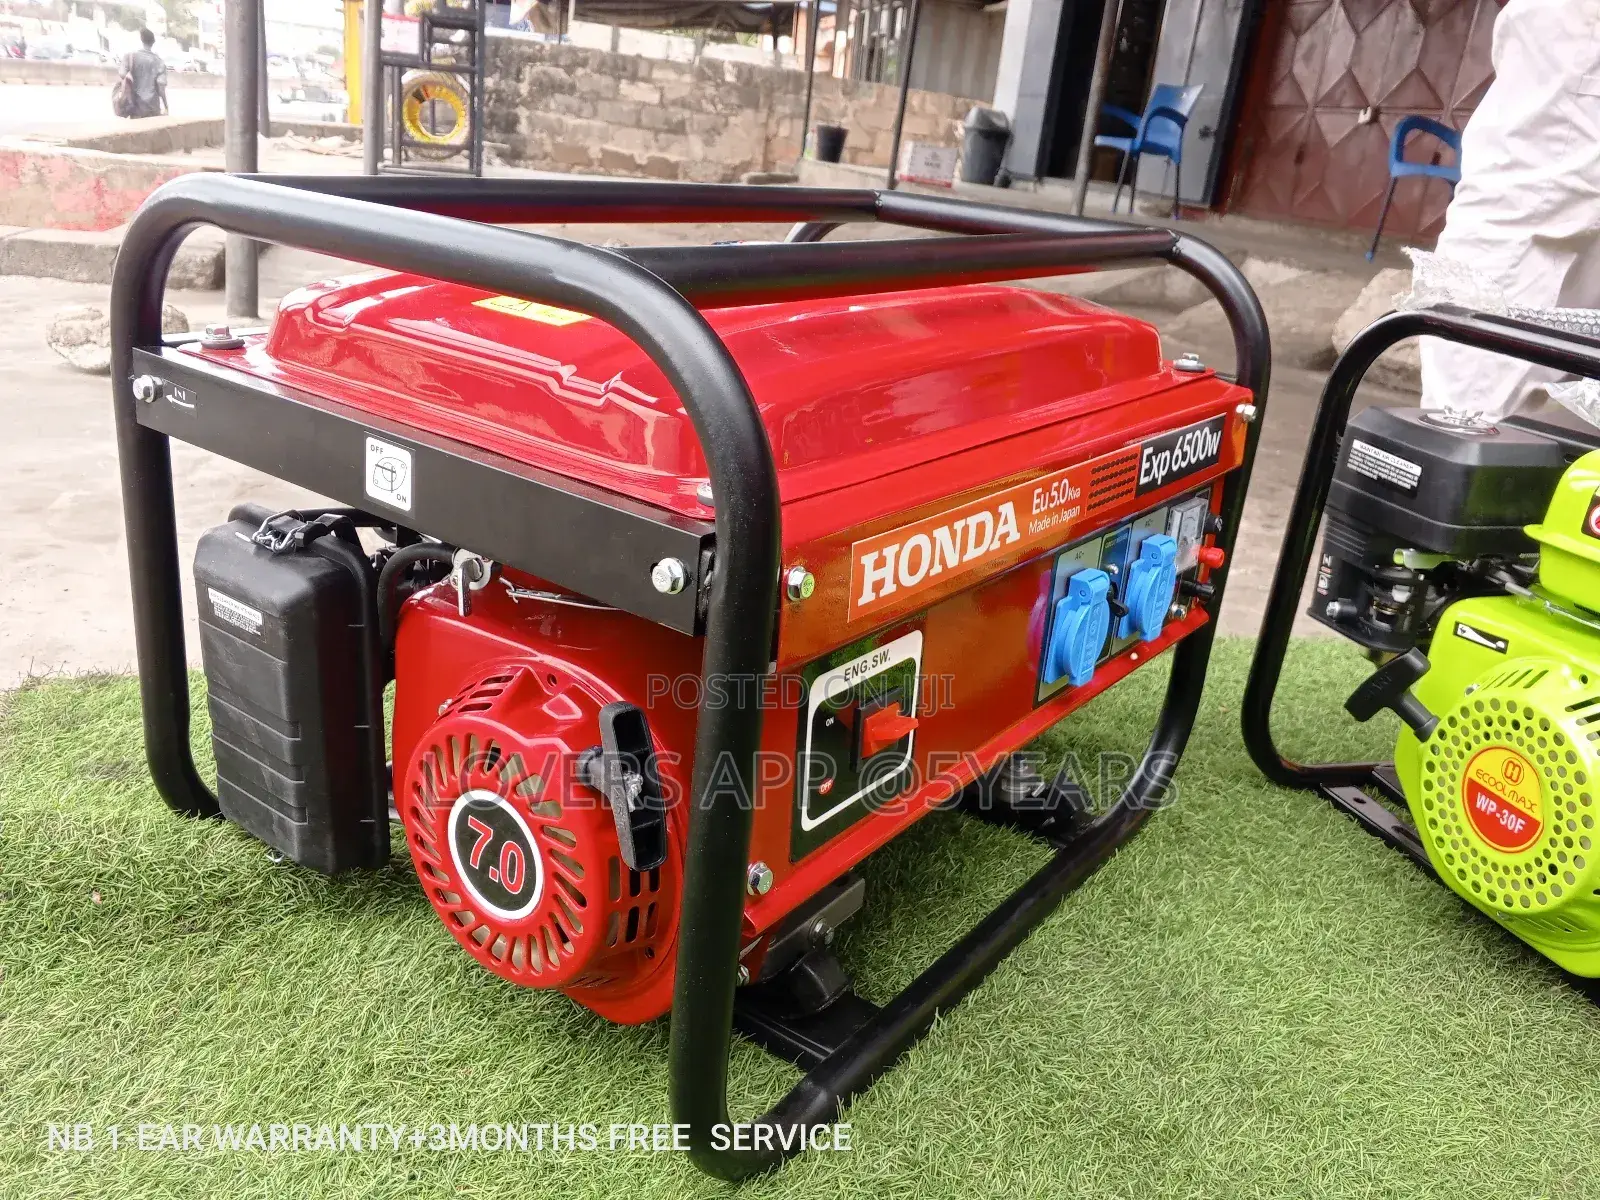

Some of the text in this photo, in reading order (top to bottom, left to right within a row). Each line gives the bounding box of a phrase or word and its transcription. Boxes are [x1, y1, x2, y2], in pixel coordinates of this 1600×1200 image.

[370, 444, 384, 455] OFF
[1139, 426, 1222, 485] Exp 6500w
[396, 493, 407, 503] ON
[1028, 505, 1081, 536] Made in Japan
[857, 501, 1021, 607] HONDA
[843, 648, 891, 682] ENG.SW.
[825, 717, 835, 727] ON
[820, 780, 834, 793] OFF
[1475, 768, 1538, 813] ECOOLMAX
[1475, 791, 1527, 834] WP-30F
[467, 814, 526, 895] 7.0
